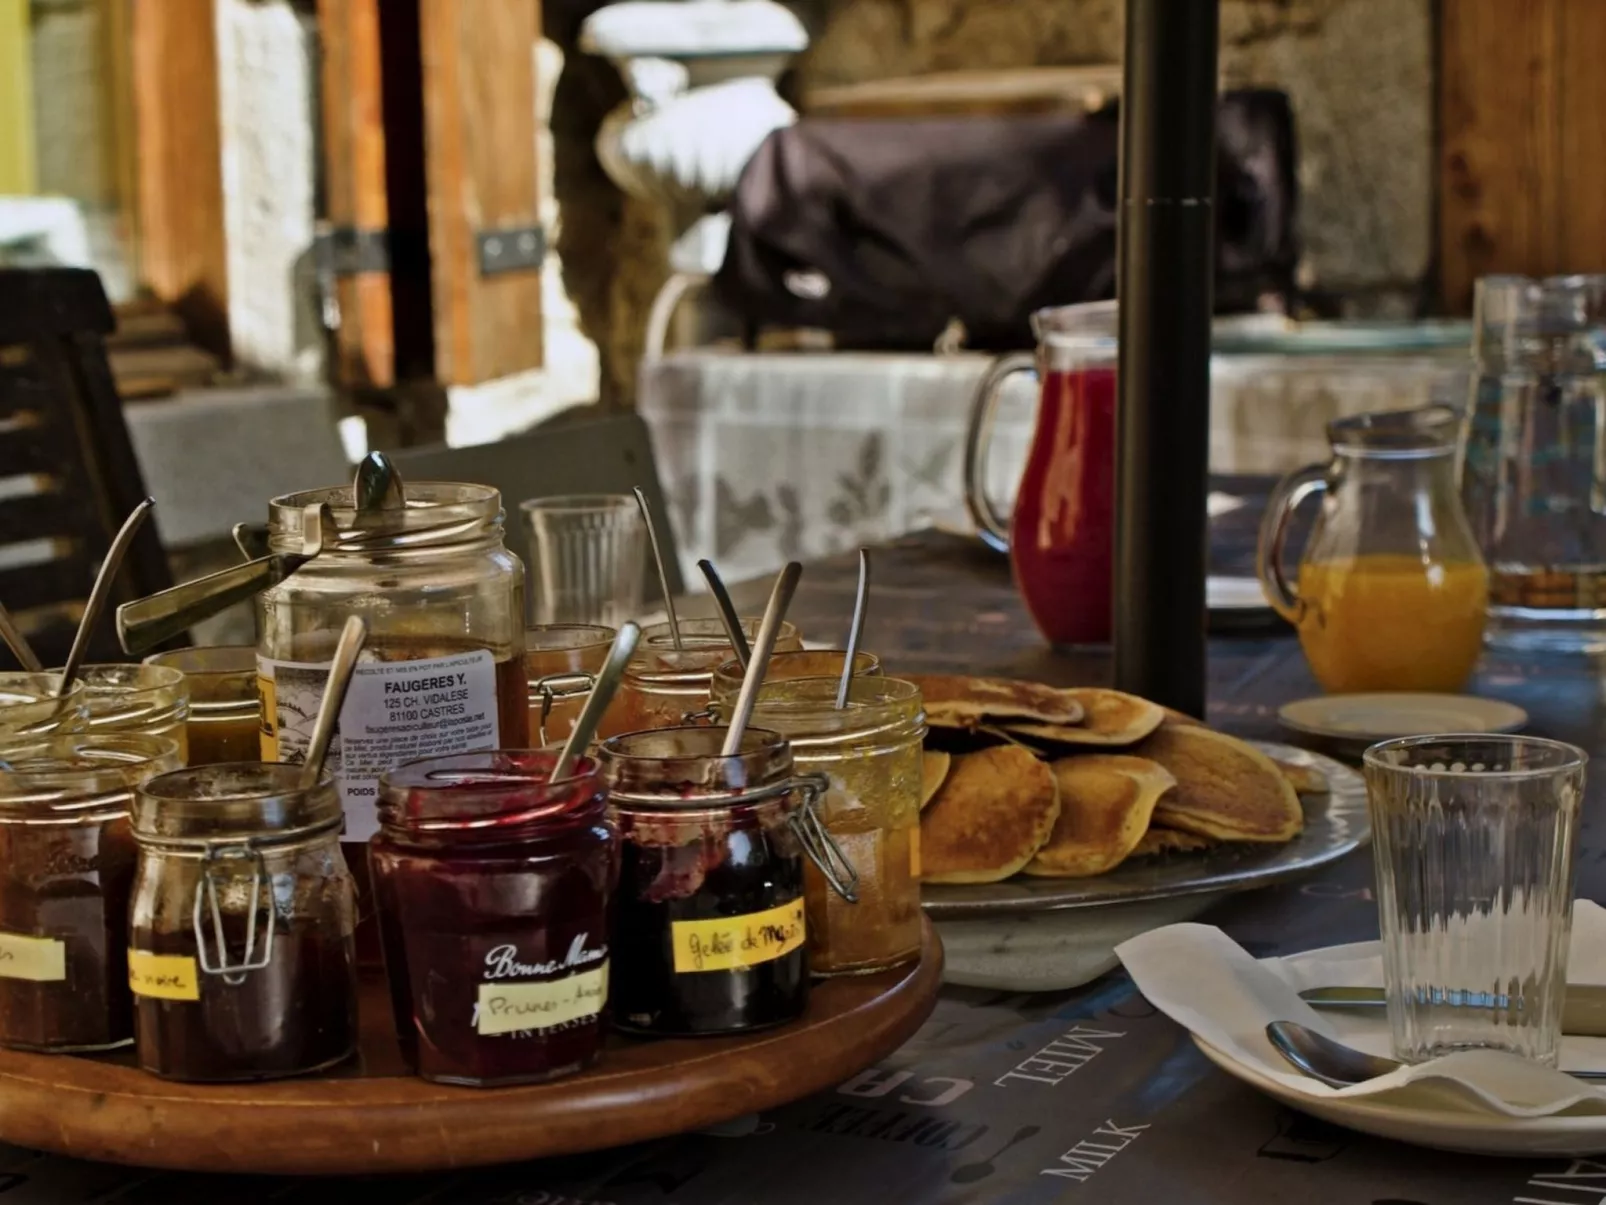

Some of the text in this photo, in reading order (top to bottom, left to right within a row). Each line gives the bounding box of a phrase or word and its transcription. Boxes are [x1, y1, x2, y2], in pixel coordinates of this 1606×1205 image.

[384, 673, 467, 694] FAUGERES Y.
[384, 689, 469, 709] 125 CH. VIDALESE
[389, 703, 465, 722] 81100 CASTRES
[347, 787, 376, 797] POIDS
[483, 943, 557, 979] Bonne
[993, 1025, 1128, 1088] MIEL
[802, 1103, 989, 1151] COFFEE
[1039, 1118, 1152, 1183] MILK
